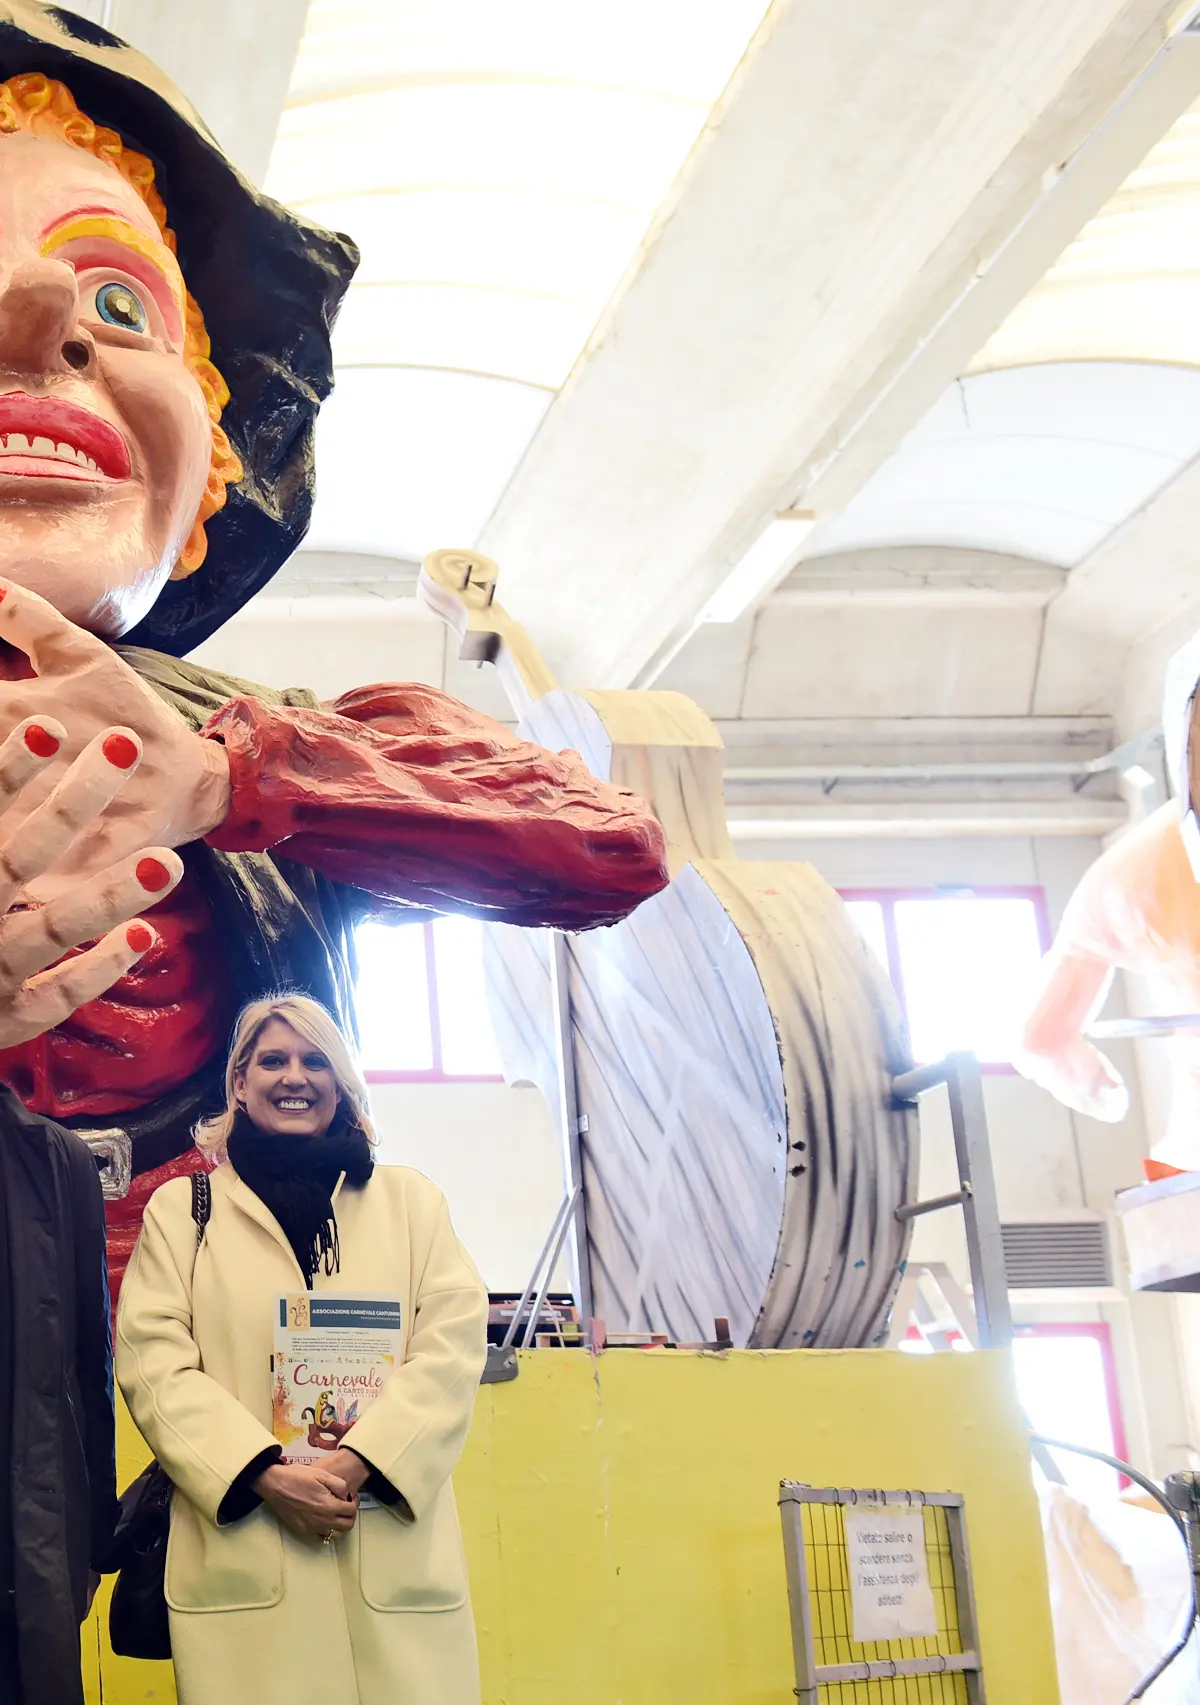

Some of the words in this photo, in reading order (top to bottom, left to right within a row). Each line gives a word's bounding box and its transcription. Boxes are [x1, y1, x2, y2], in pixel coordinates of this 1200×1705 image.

[293, 1363, 383, 1388] Carnevale
[856, 1531, 882, 1544] Vietato
[884, 1531, 905, 1544] salire
[907, 1533, 913, 1543] o
[891, 1553, 915, 1564] senza
[877, 1593, 904, 1607] addetti
